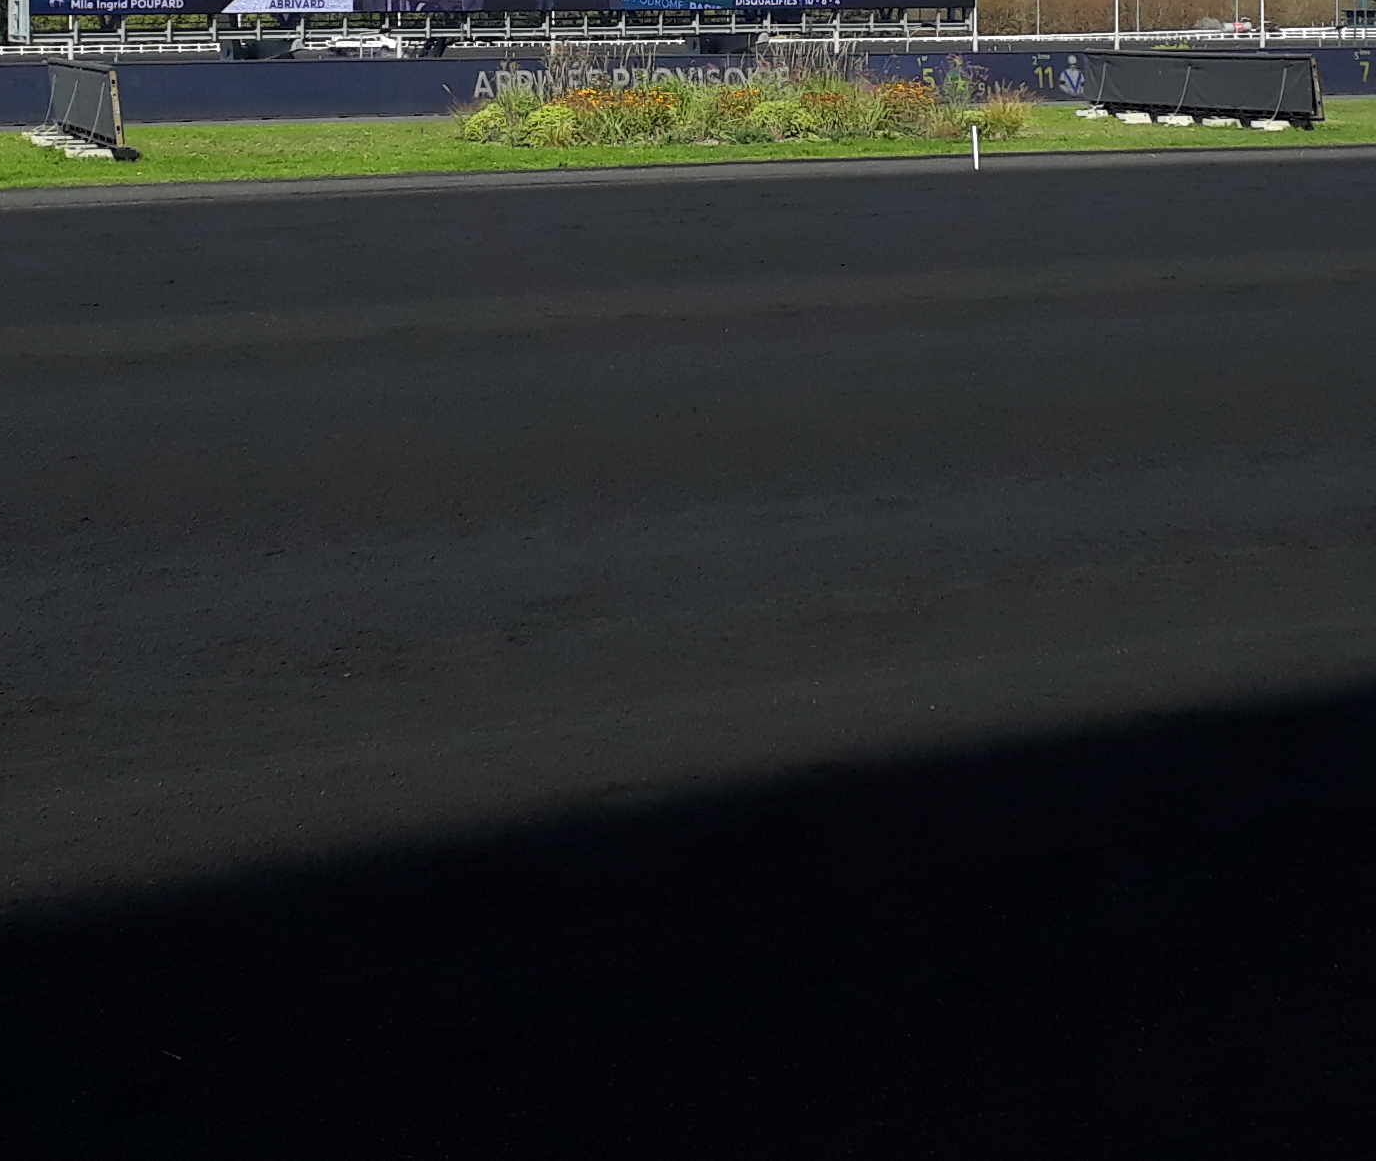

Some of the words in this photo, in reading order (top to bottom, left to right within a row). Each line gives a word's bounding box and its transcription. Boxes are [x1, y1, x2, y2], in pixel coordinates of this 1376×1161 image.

[71, 0, 94, 9] Mlle
[96, 0, 128, 10] Ingrid
[130, 0, 184, 9] POUPARD
[269, 0, 325, 9] ABRIVARD
[1034, 66, 1055, 89] 11
[1360, 61, 1370, 83] 7
